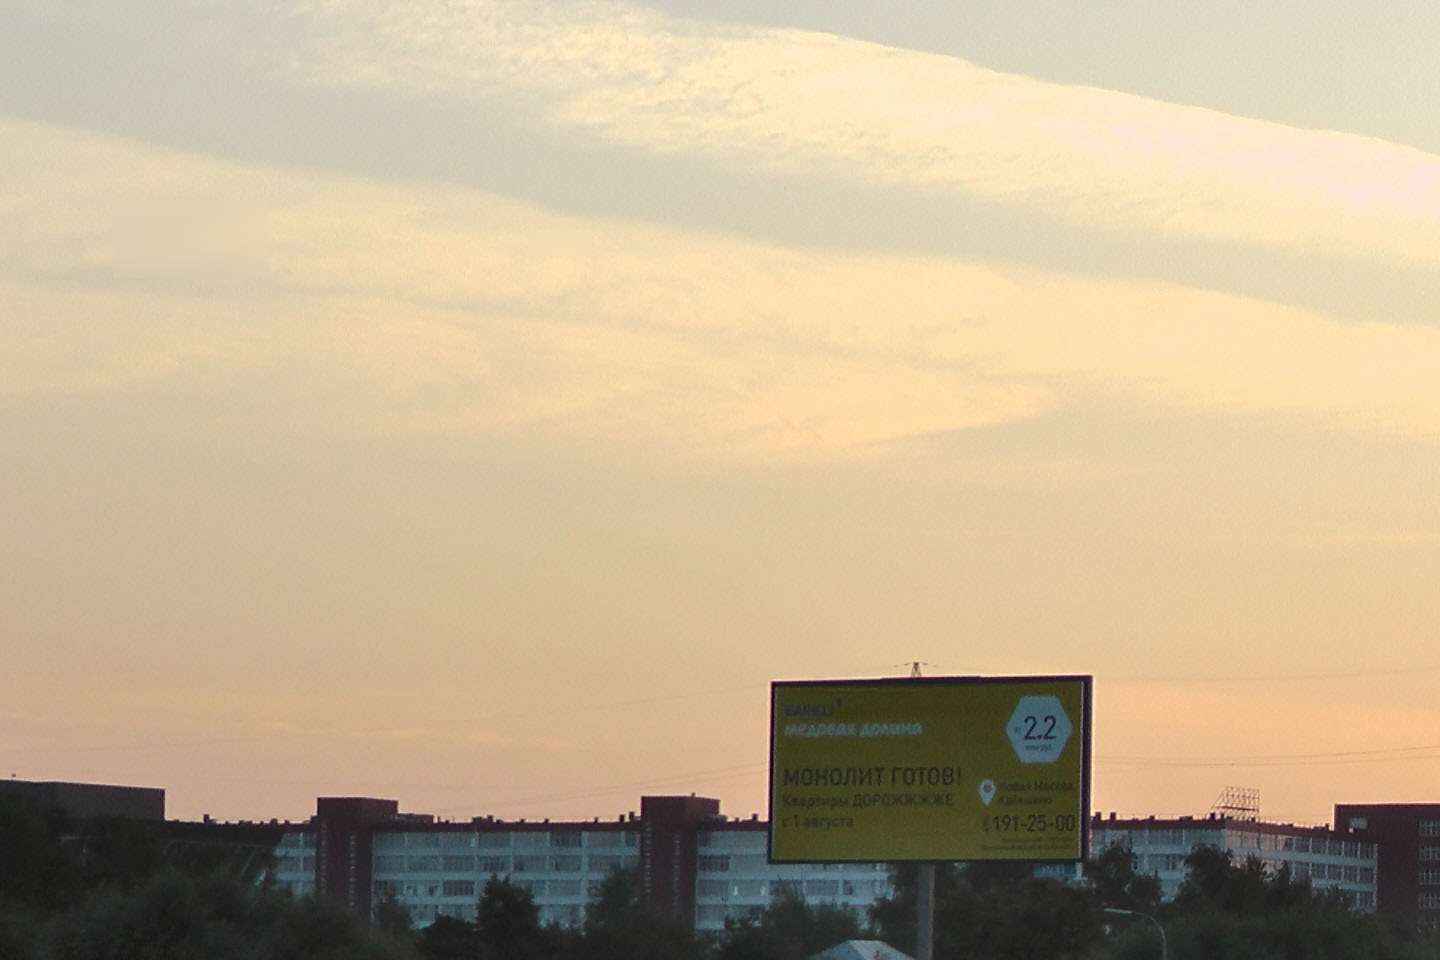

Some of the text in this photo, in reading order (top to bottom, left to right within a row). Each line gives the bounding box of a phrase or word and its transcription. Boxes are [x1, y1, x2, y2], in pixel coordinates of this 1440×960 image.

[1024, 715, 1056, 740] 2.2
[783, 766, 962, 786] МОНОЛИТ ГОТОВ!
[992, 814, 1076, 833] 191-25-00
